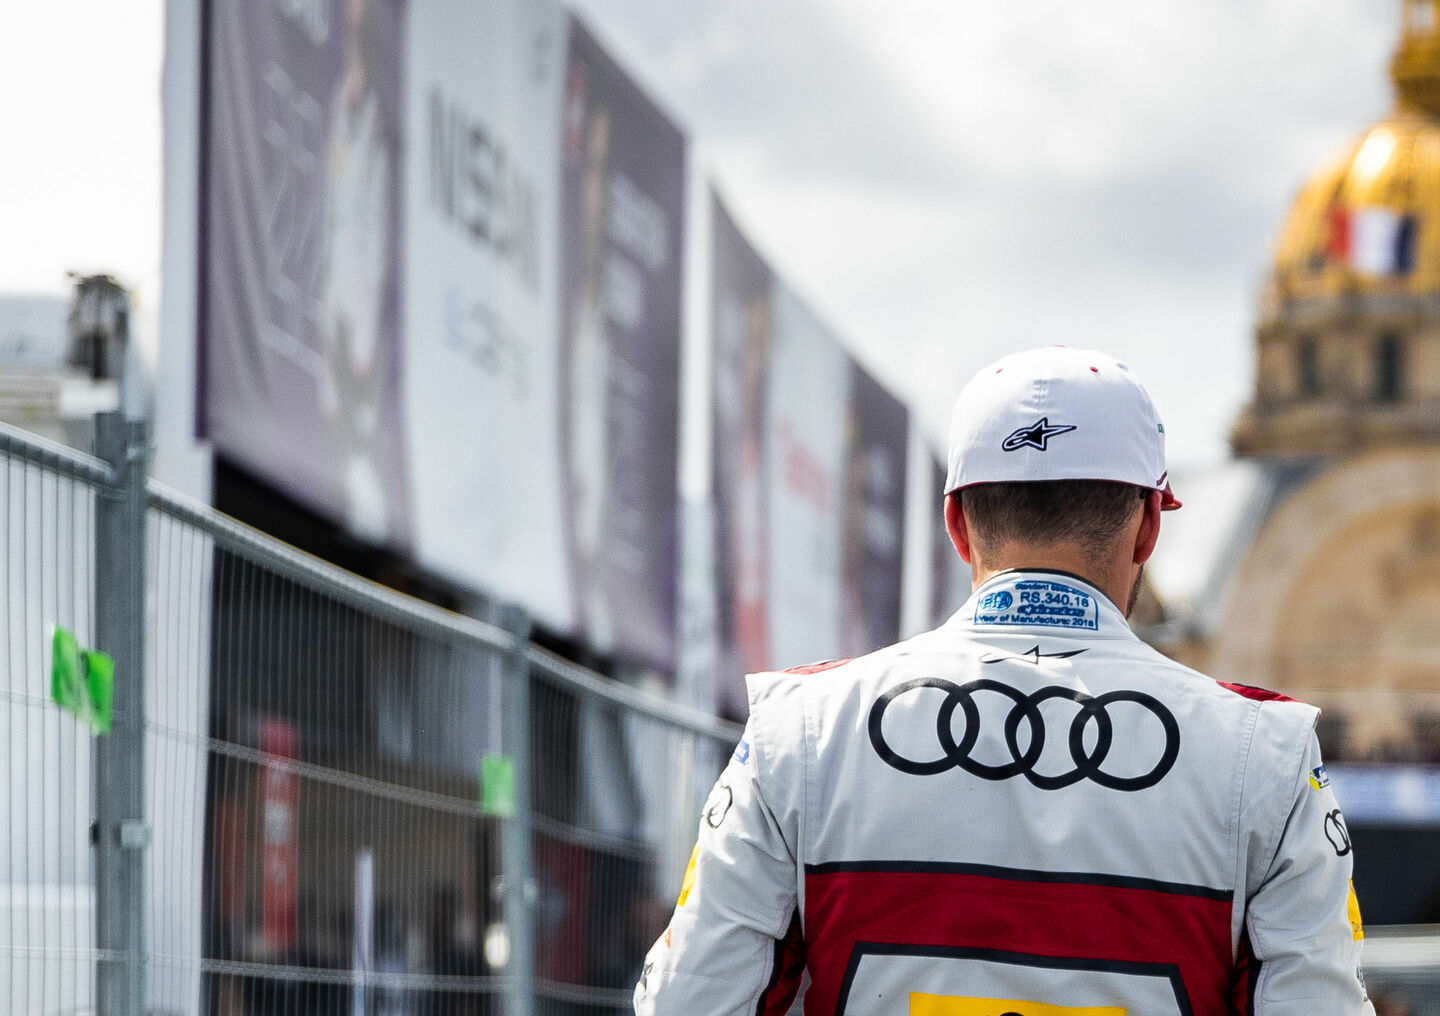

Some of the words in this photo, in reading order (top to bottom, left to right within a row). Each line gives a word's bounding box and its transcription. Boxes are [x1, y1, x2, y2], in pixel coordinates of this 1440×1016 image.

[1020, 591, 1089, 607] RS.340.18
[999, 614, 1010, 622] of
[1011, 614, 1070, 625] Manufacture:
[1072, 618, 1094, 627] 2018
